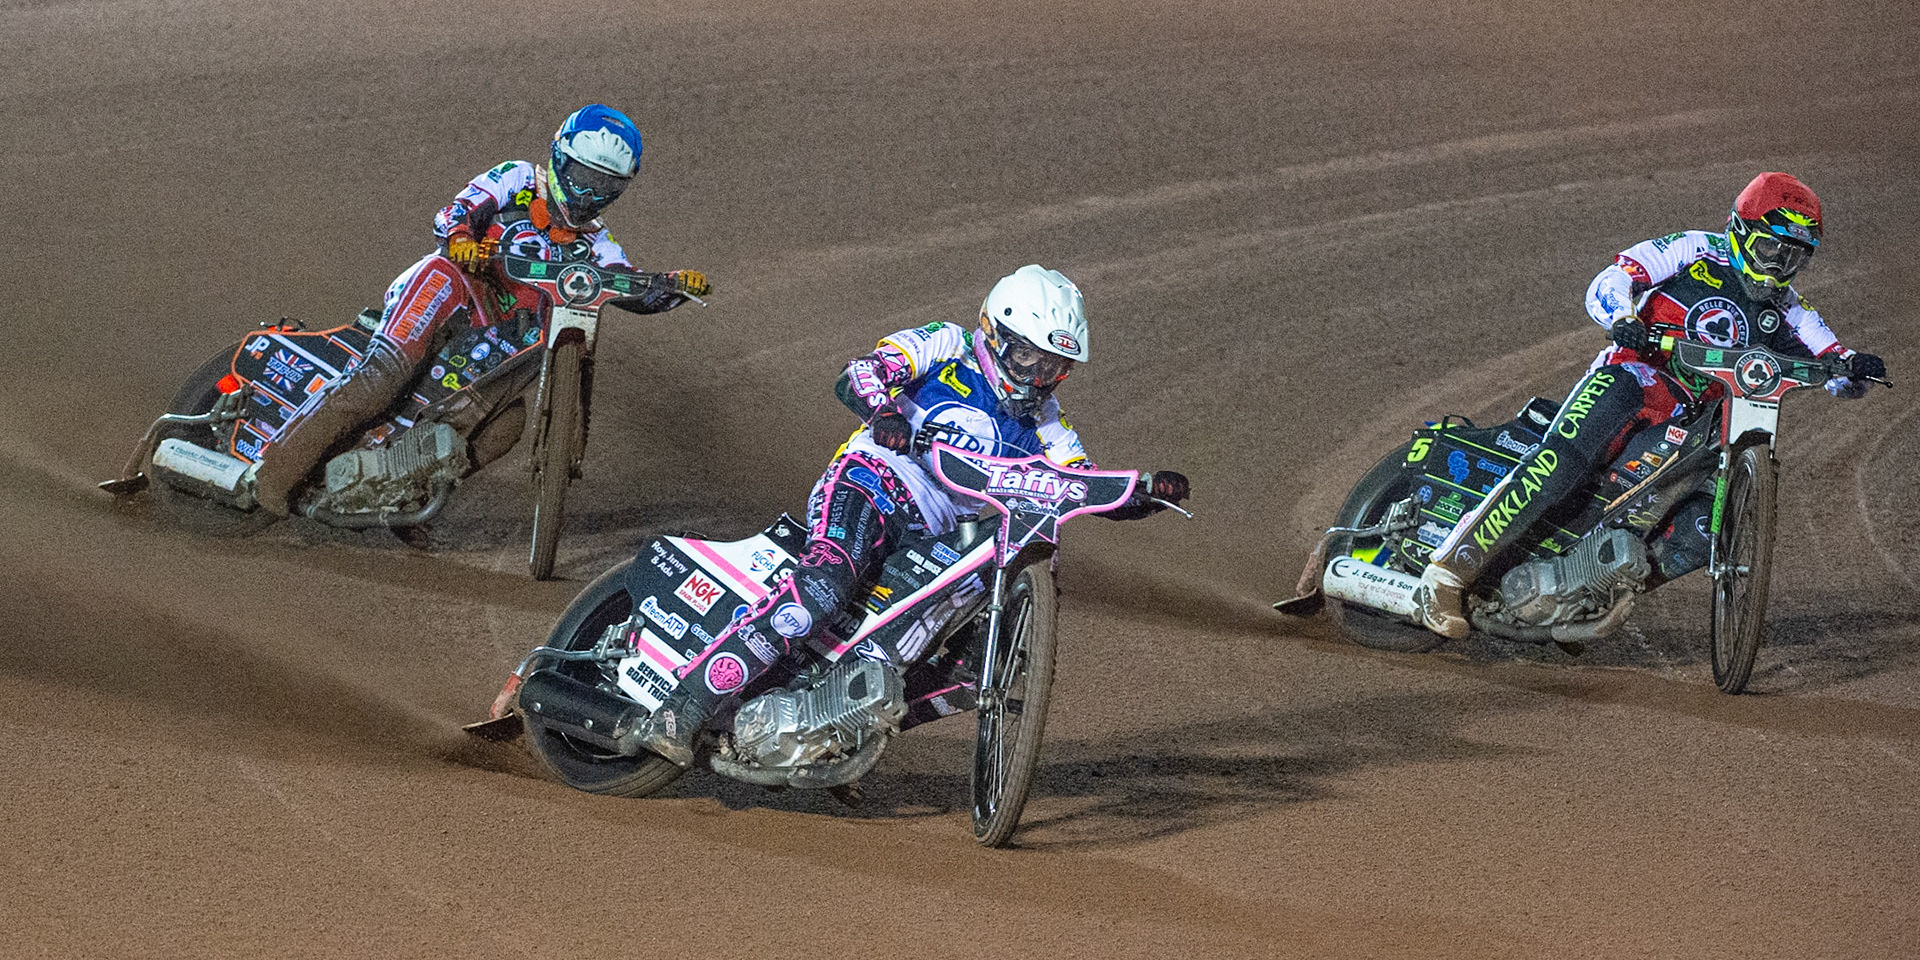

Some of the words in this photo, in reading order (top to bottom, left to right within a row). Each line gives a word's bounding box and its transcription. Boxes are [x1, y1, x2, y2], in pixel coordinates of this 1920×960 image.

[410, 298, 442, 339] TRAINING
[1699, 300, 1723, 312] BELLE
[1726, 304, 1738, 317] VUE
[1736, 319, 1746, 343] ACES
[244, 336, 271, 353] JP
[1053, 335, 1077, 349] STS
[1738, 354, 1754, 367] BELLE
[1768, 358, 1779, 373] ACES
[1495, 430, 1536, 455] #team
[1667, 428, 1686, 441] NGK
[1407, 438, 1433, 462] 5
[1473, 449, 1558, 553] KIRKLAND
[1558, 372, 1615, 439] CARPETS
[1477, 457, 1507, 477] Grant
[988, 465, 1087, 501] Taffys
[830, 490, 849, 527] PRESTIGE
[1019, 500, 1060, 517] Silkolene
[650, 555, 660, 565] &
[657, 561, 674, 578] Ada
[651, 541, 668, 559] Roy,
[667, 553, 689, 574] Jinny
[751, 550, 775, 571] FUCHS
[684, 574, 720, 606] NGK
[1351, 569, 1360, 577] J.
[1361, 571, 1387, 583] Edgar
[1387, 578, 1395, 586] &
[1396, 580, 1413, 591] Son
[678, 589, 693, 602] SPARK
[691, 598, 707, 613] PLUGS
[641, 598, 686, 637] #teamATPI
[780, 612, 803, 632] ATPI
[690, 623, 715, 644] Gran
[625, 666, 649, 688] BOAT
